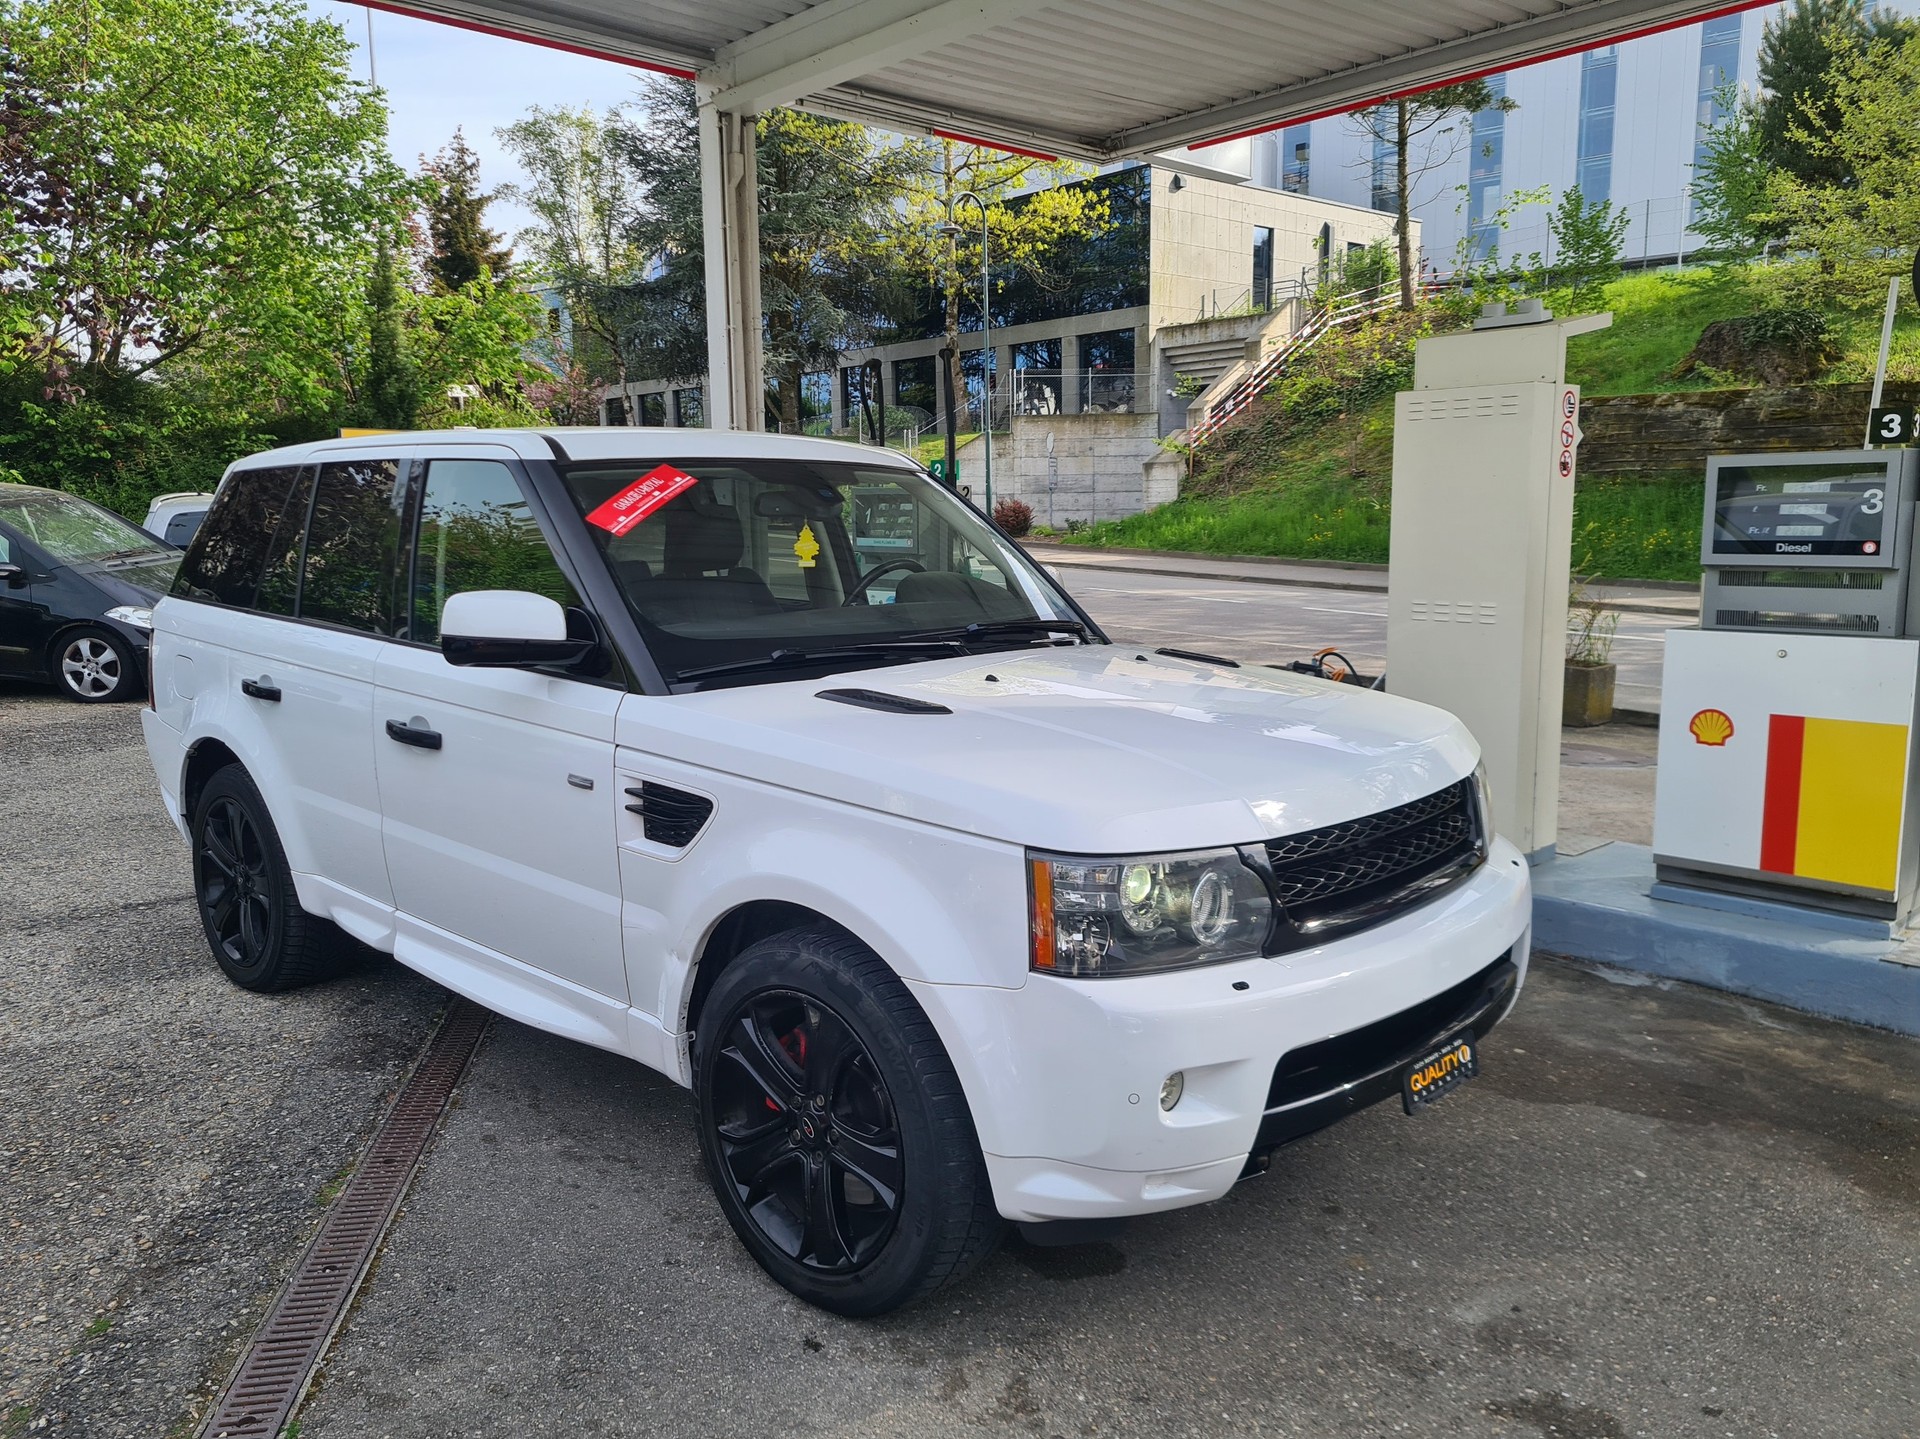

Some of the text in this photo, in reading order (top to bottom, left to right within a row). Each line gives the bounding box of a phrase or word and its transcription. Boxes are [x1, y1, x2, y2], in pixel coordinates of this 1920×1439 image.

[1880, 413, 1902, 438] 3
[934, 463, 942, 477] 2
[1860, 488, 1884, 515] 3
[865, 507, 871, 524] 1
[1775, 543, 1812, 553] Diesel
